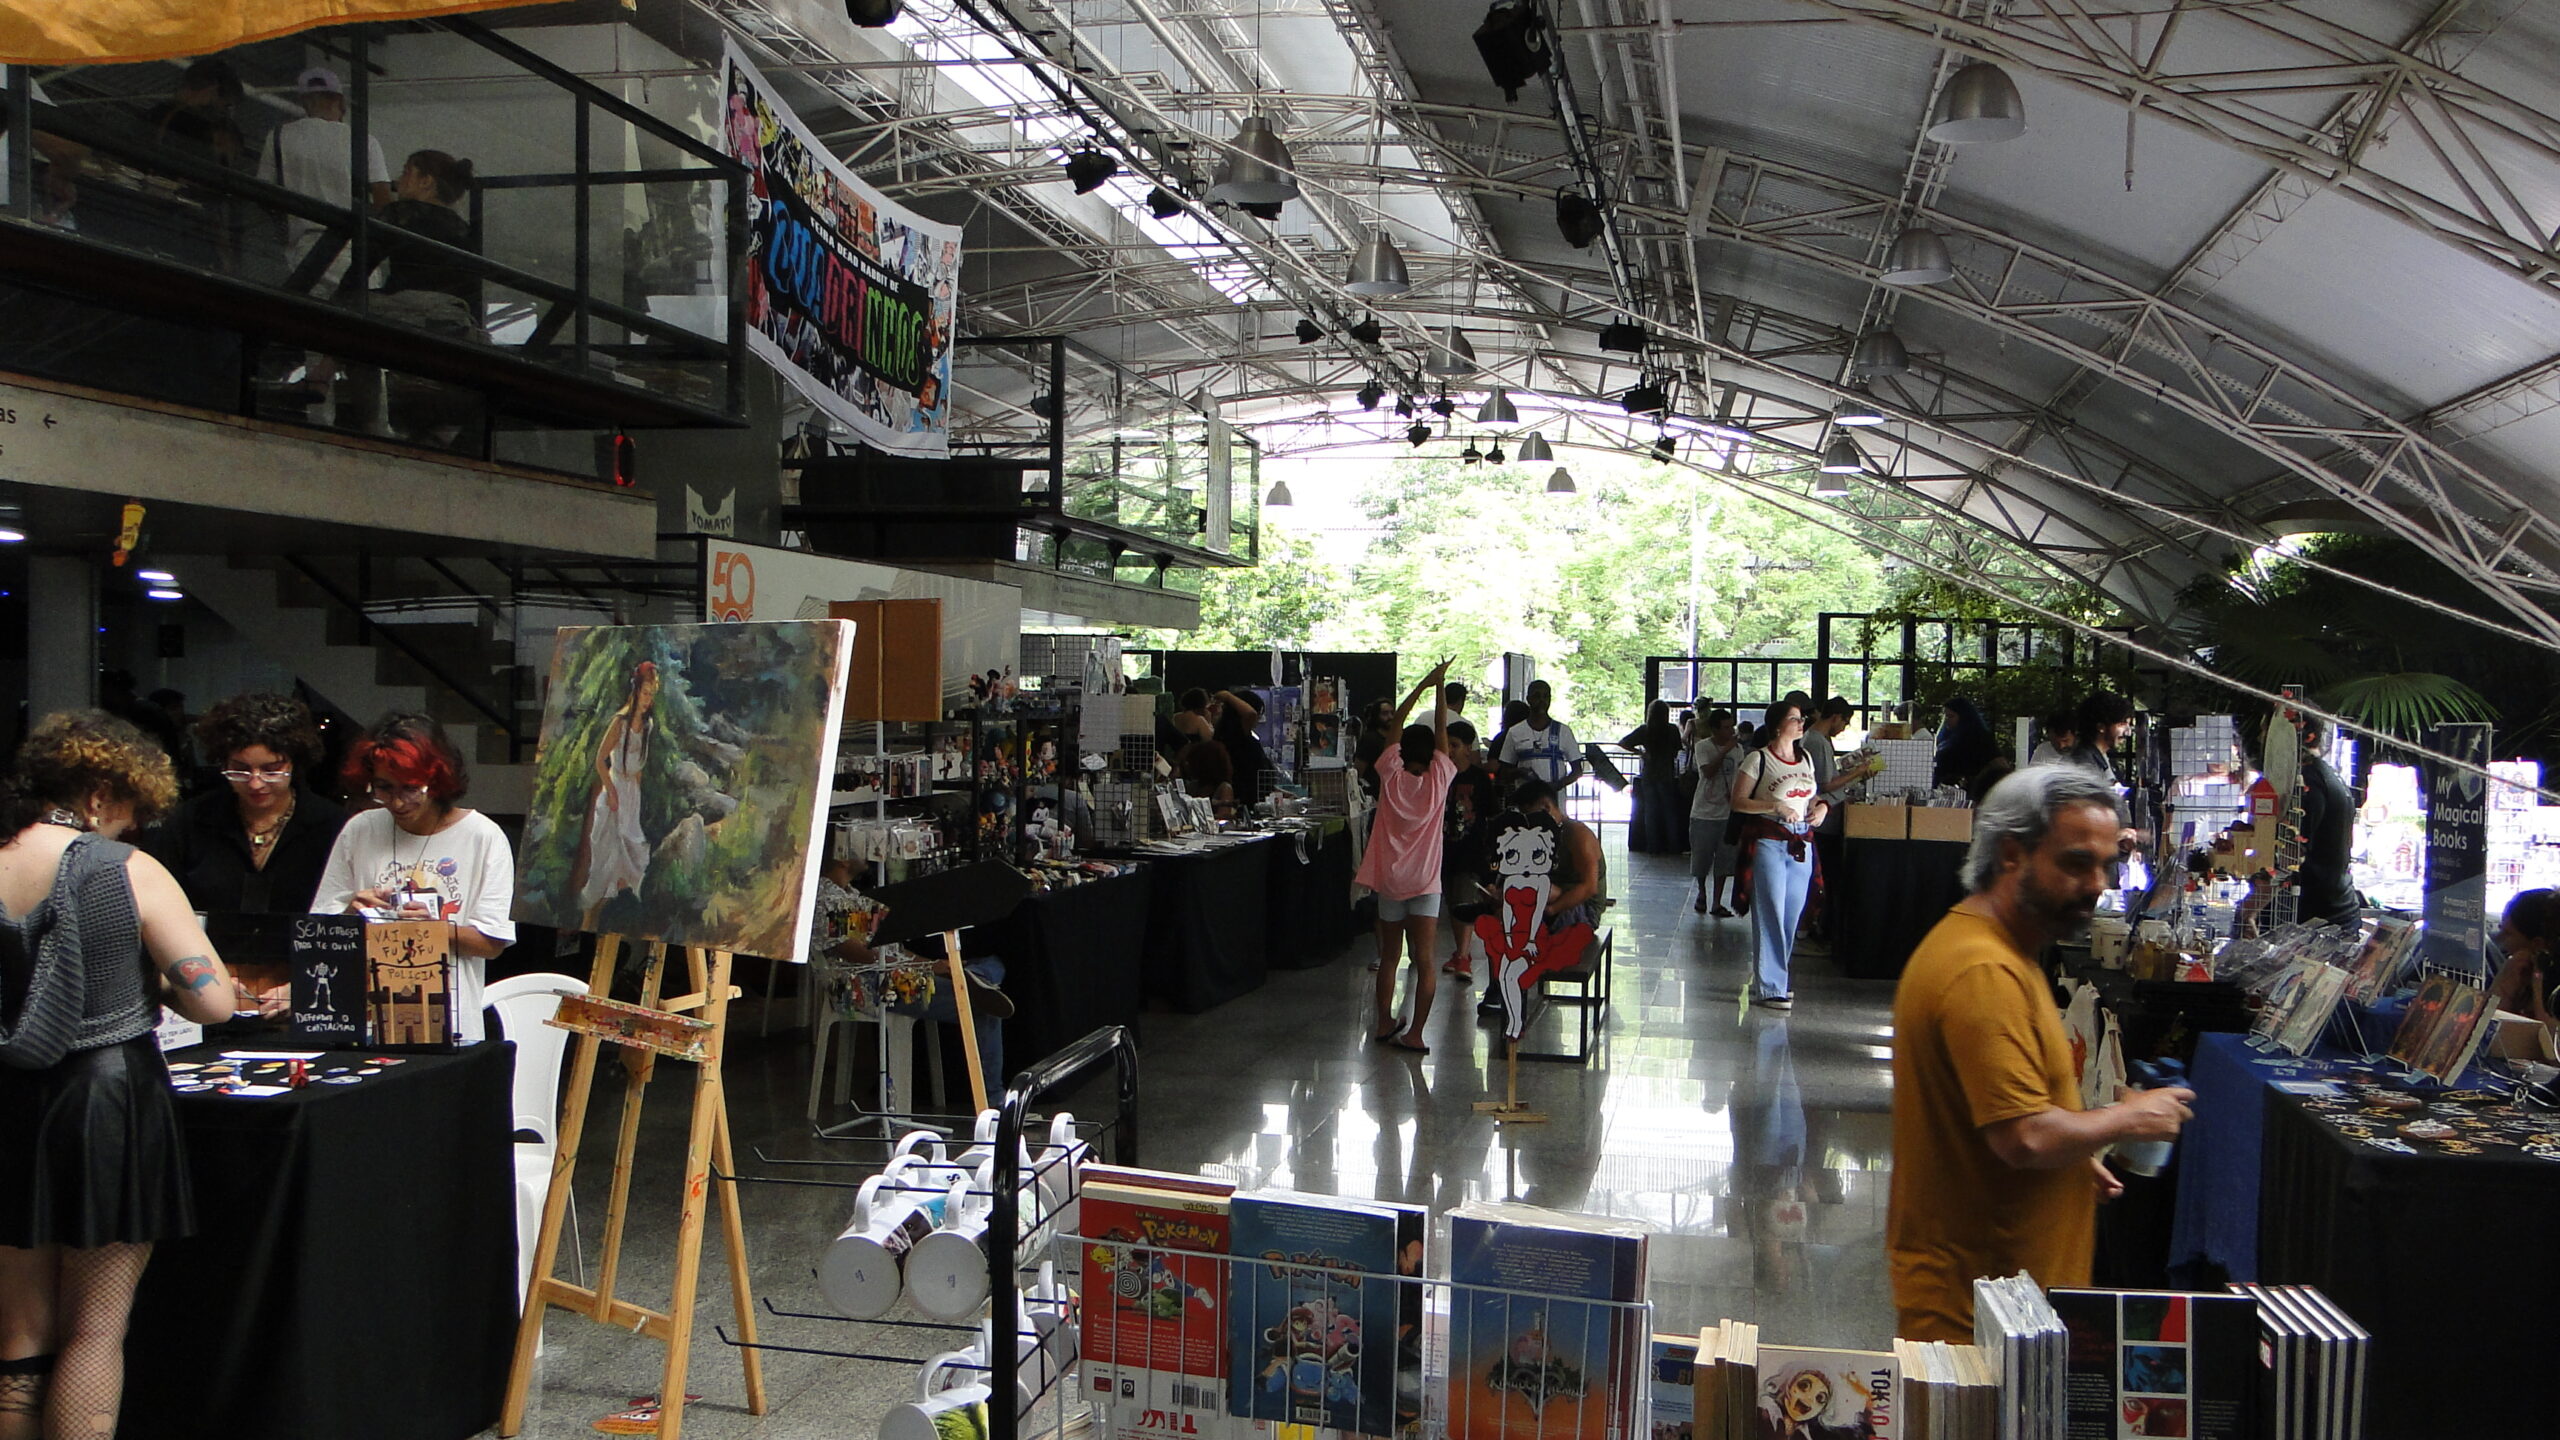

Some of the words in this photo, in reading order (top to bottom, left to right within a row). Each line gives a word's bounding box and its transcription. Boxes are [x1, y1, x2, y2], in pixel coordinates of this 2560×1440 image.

[809, 215, 835, 249] FEIRA
[836, 242, 859, 268] DEAD
[860, 260, 888, 288] RABBIT
[889, 279, 900, 294] DE
[768, 199, 924, 386] QUADRINHOS
[691, 511, 732, 531] TOMATO
[711, 551, 756, 618] 50
[1768, 773, 1798, 792] CHERRY
[2435, 775, 2453, 800] My
[2433, 803, 2484, 827] Magical
[2433, 828, 2468, 851] Books
[295, 919, 326, 939] SEM
[374, 929, 400, 944] VAI
[331, 941, 358, 951] OUVIR
[382, 946, 398, 957] FU
[417, 944, 434, 956] FU
[341, 1014, 349, 1023] O
[1870, 1367, 1892, 1426] TOKYO
